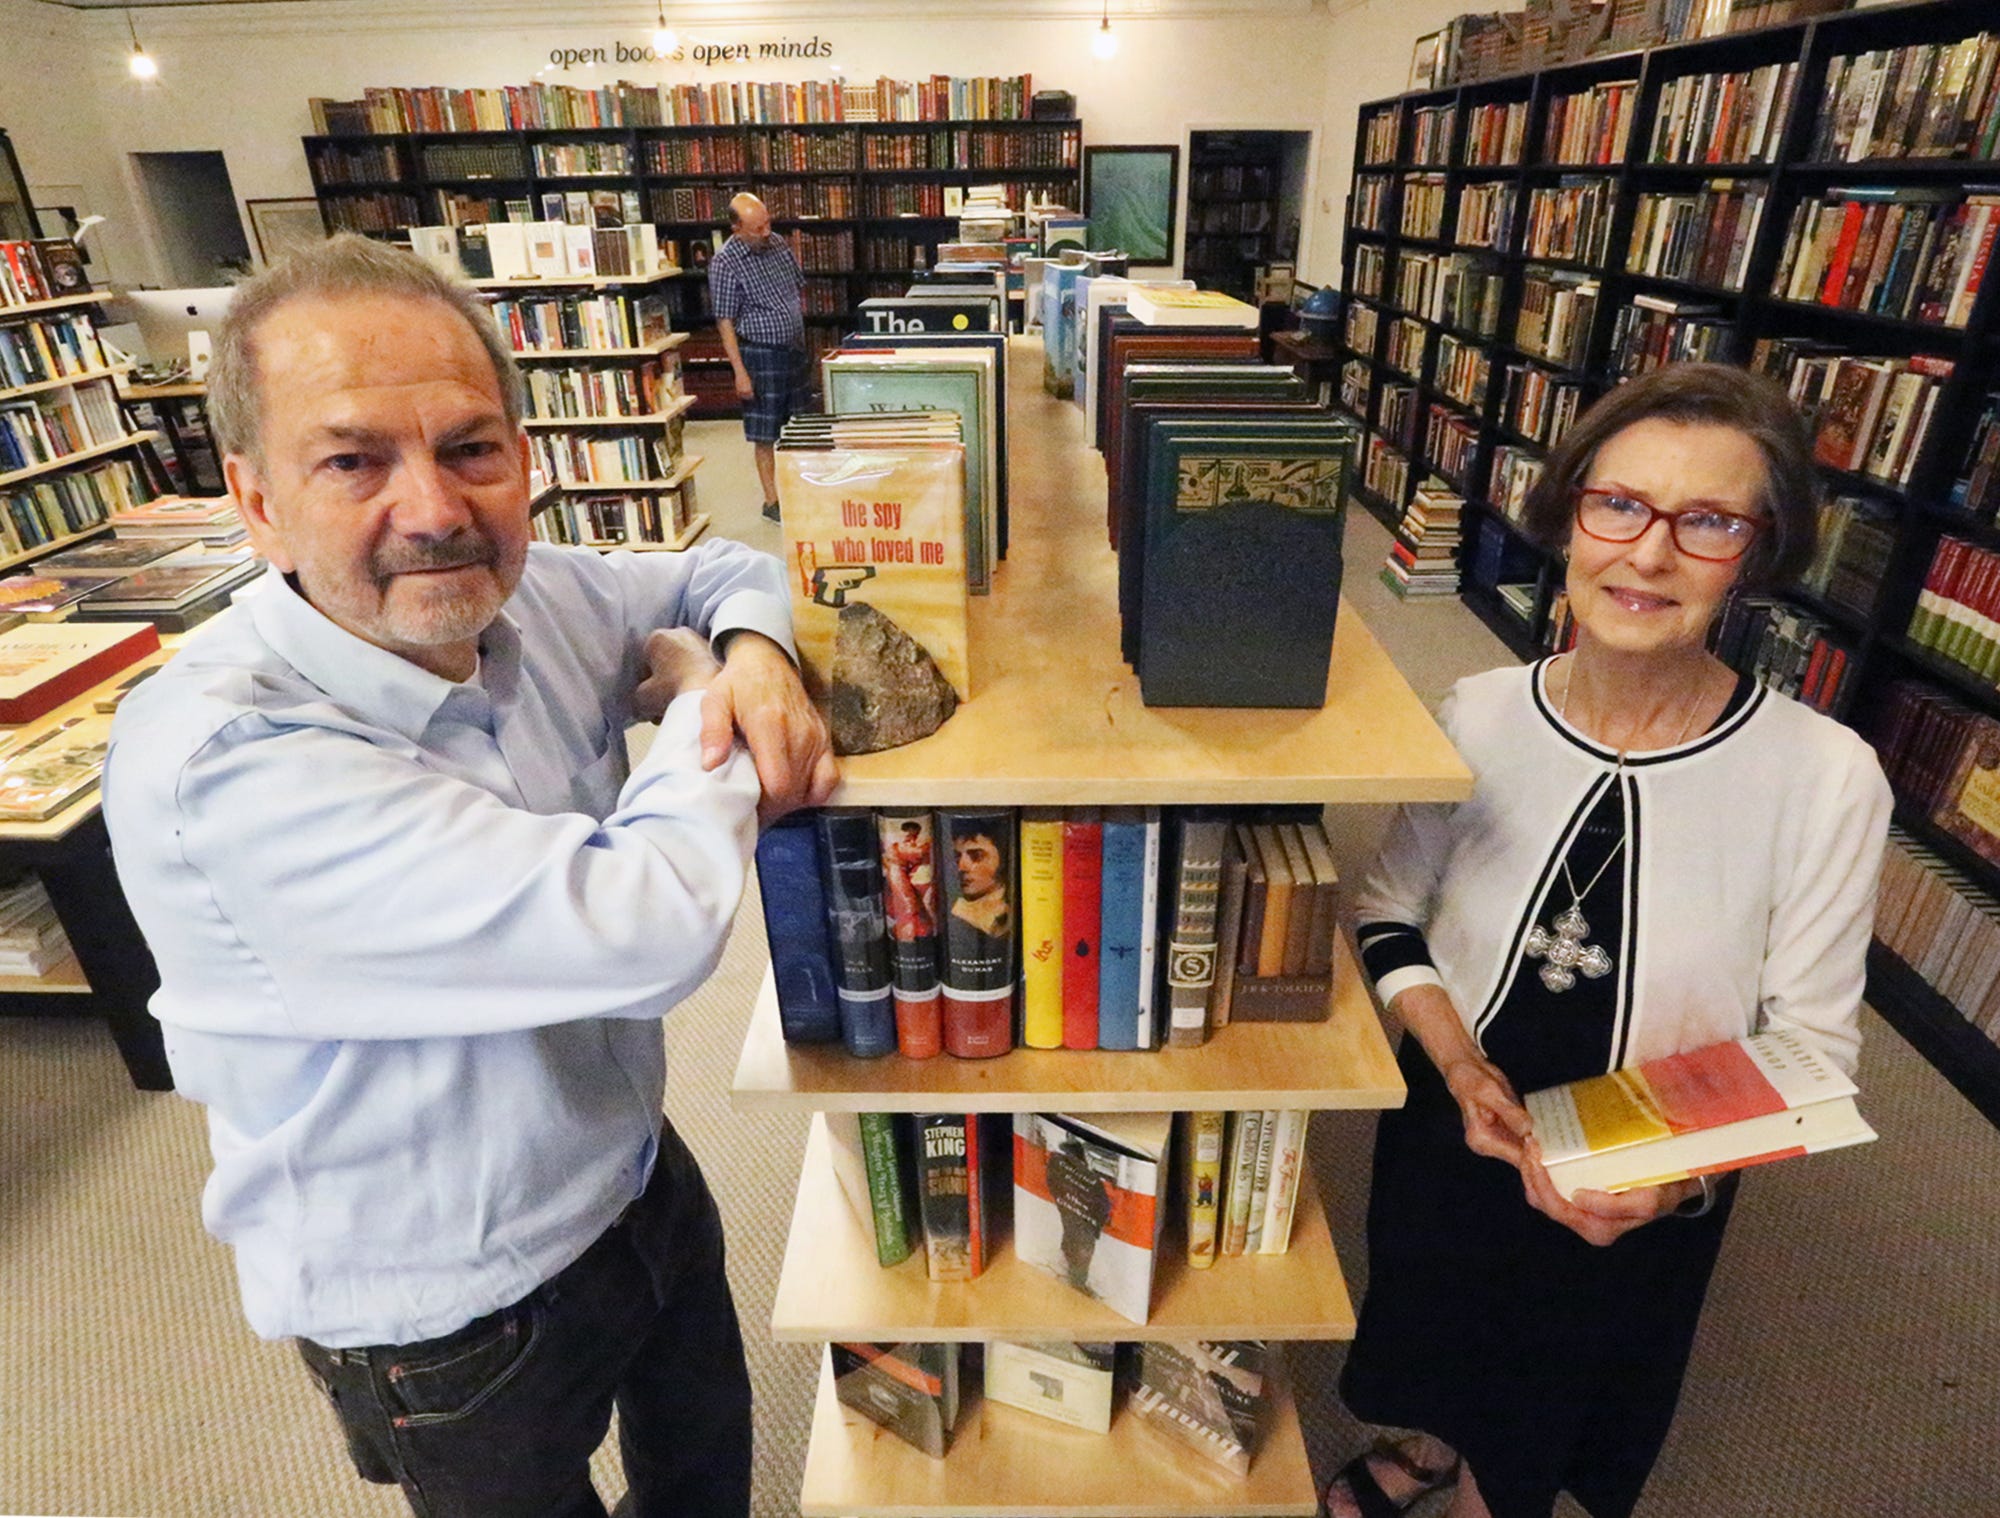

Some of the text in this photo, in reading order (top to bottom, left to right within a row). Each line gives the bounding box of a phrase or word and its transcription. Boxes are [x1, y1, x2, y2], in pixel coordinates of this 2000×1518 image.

[550, 36, 833, 70] open boos open minds
[864, 311, 925, 333] The
[841, 499, 902, 531] the spy
[831, 536, 945, 566] who loved me
[950, 957, 1003, 966] ALEXANDRE
[960, 966, 994, 974] DUMAS
[1273, 984, 1326, 993] TOLKIEN
[924, 1126, 965, 1141] STEPHEN
[926, 1138, 966, 1158] KING
[1135, 1384, 1243, 1460] Young
